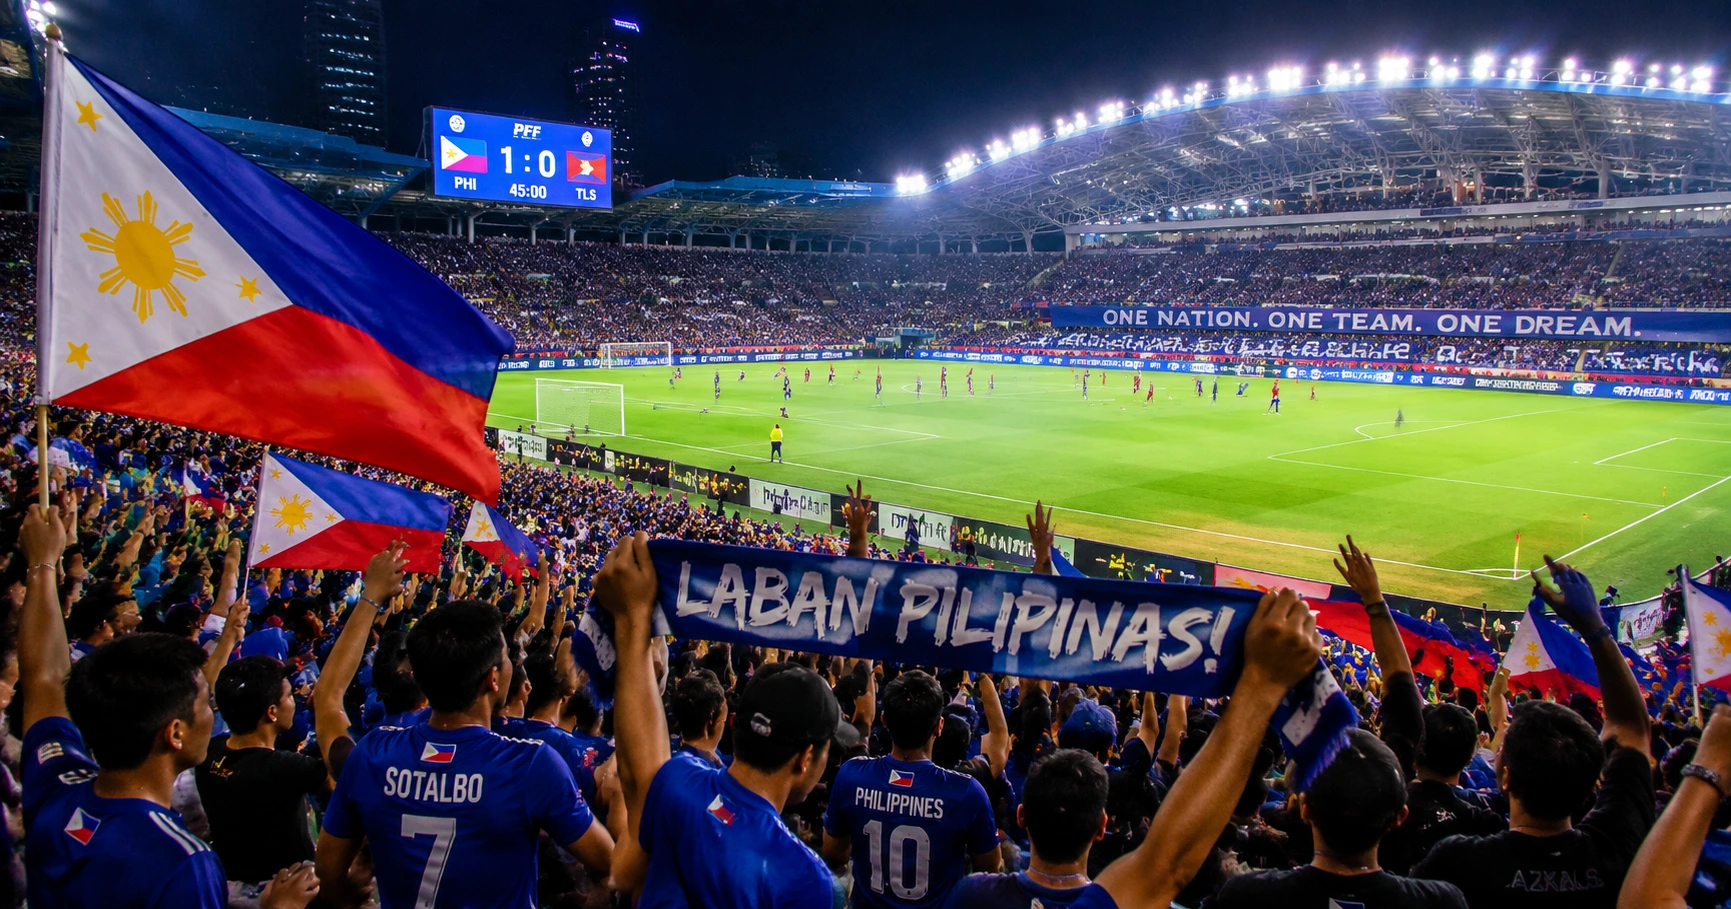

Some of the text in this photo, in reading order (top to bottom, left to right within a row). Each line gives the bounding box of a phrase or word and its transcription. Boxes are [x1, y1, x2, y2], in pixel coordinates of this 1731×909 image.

[513, 122, 542, 137] PFF
[454, 176, 477, 191] PHI
[509, 183, 547, 199] 45:00
[576, 187, 597, 201] TLS
[1103, 309, 1642, 338] ONE NATION. ONE TEAM. ONE DREAM.
[676, 561, 1236, 675] LABAN PILIPINAS!
[383, 766, 483, 803] SOTALBO
[855, 786, 944, 819] PHILIPPINES
[401, 814, 456, 909] 7
[863, 819, 931, 899] 10
